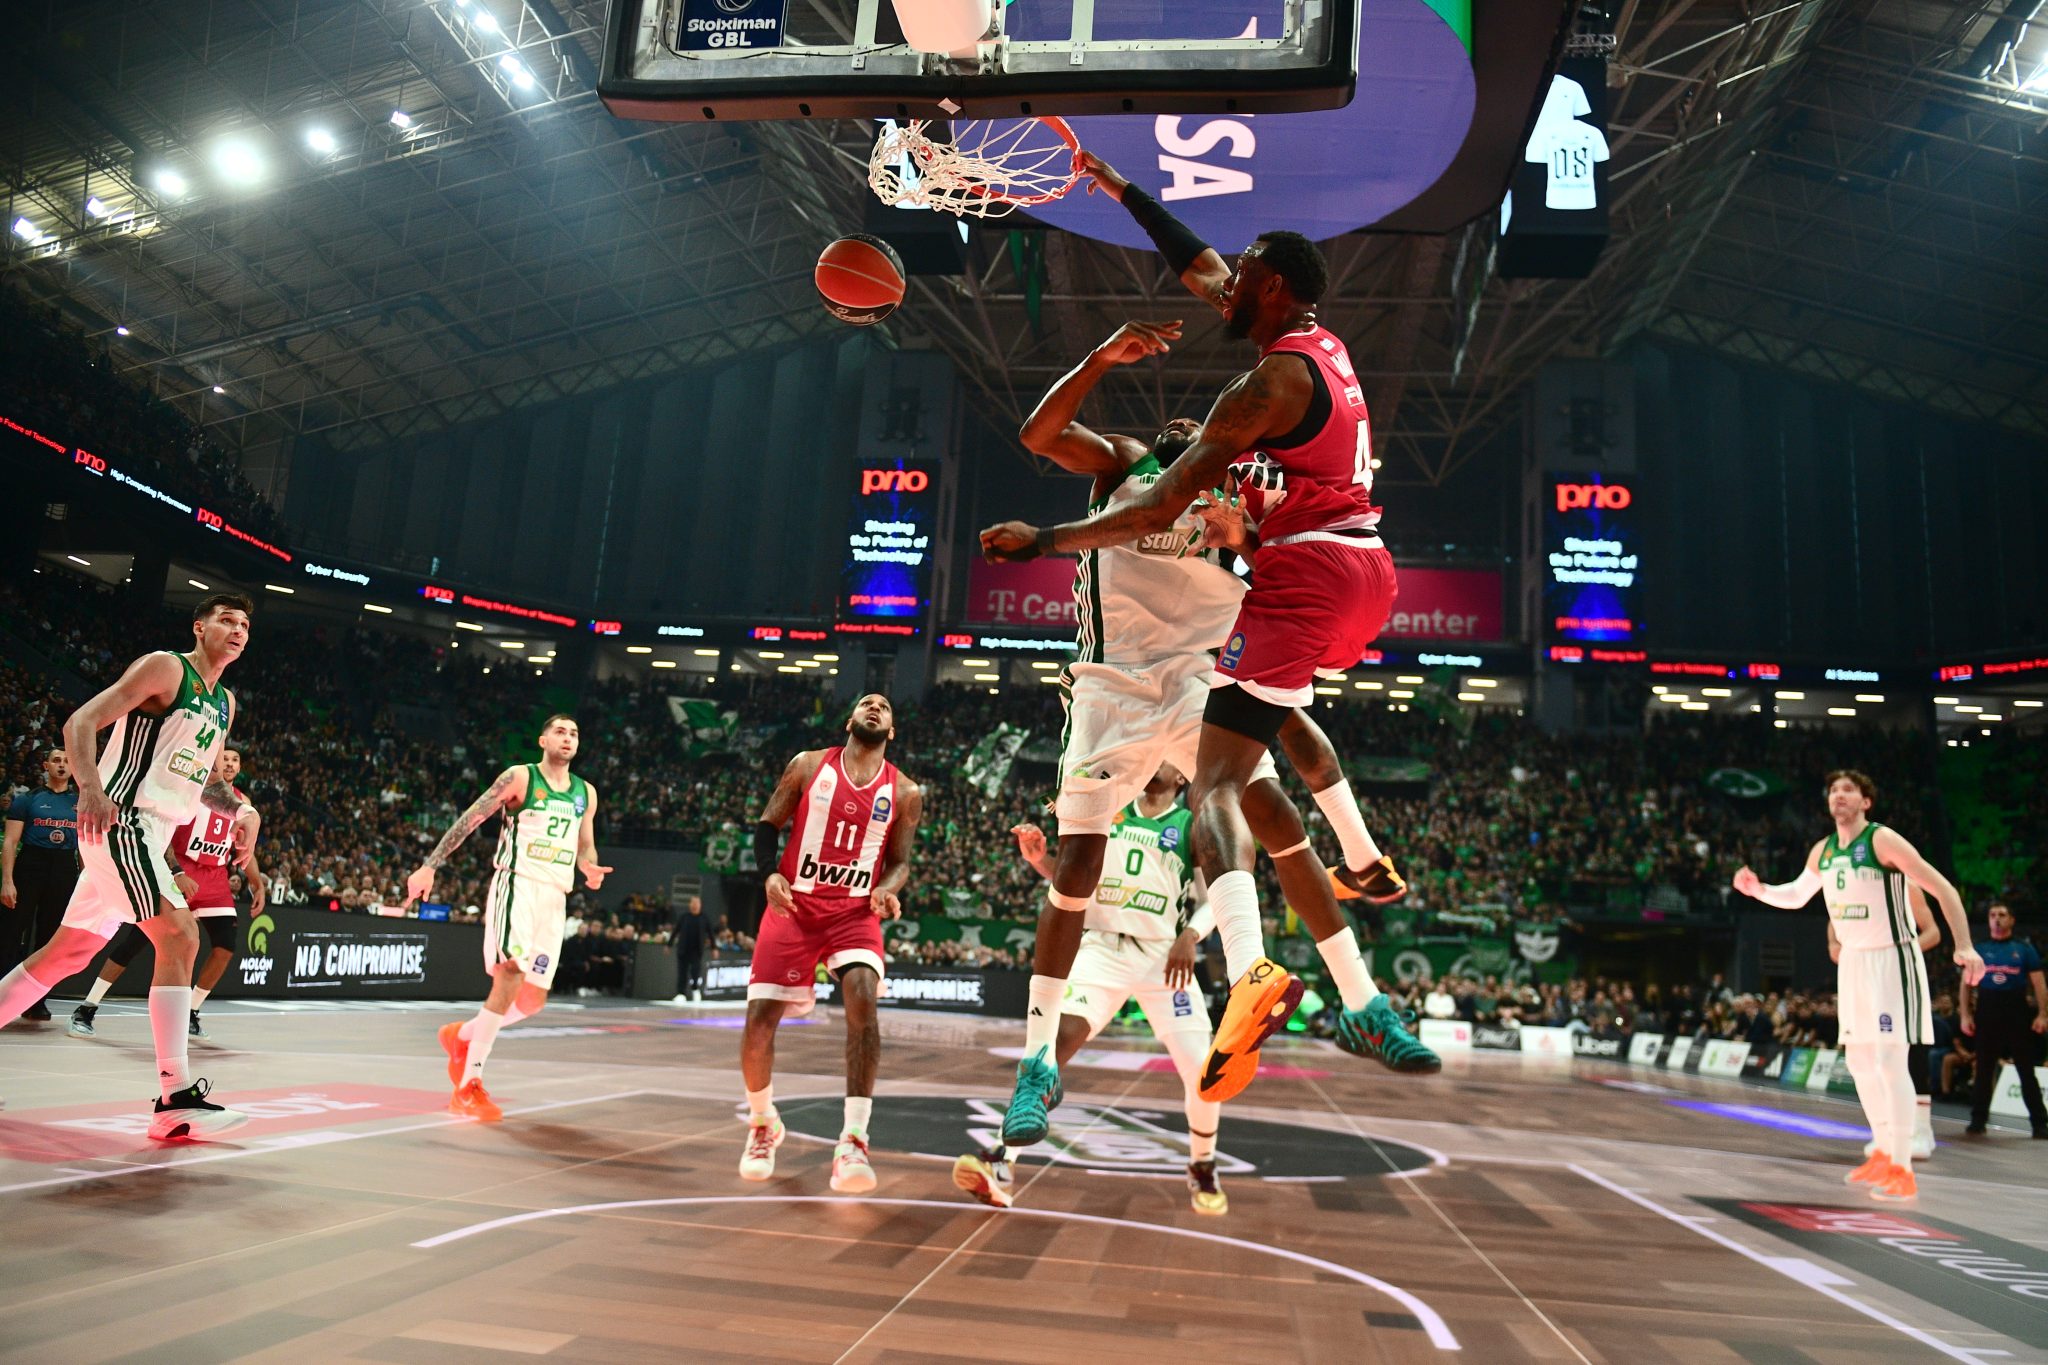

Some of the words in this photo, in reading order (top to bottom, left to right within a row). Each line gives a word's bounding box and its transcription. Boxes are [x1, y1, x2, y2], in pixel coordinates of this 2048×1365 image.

[687, 18, 776, 32] Stoiximan
[707, 31, 752, 48] GBL
[75, 448, 106, 472] pno
[110, 468, 125, 481] High
[125, 476, 157, 499] Computing
[862, 469, 929, 496] pno
[1556, 483, 1631, 512] pno
[197, 507, 223, 529] pno
[864, 519, 916, 536] Shaping
[850, 534, 871, 547] the
[871, 534, 912, 548] Future
[913, 535, 928, 548] of
[852, 548, 923, 565] Technology
[305, 562, 333, 577] Cyber
[333, 568, 370, 586] Security
[850, 594, 871, 606] pno
[1022, 594, 1079, 620] Cen
[1380, 608, 1480, 635] enter
[213, 818, 223, 835] 3
[547, 815, 571, 839] 27
[834, 820, 858, 851] 11
[799, 853, 871, 889] bwin
[1125, 848, 1144, 876] 0
[1836, 869, 1846, 890] 6
[294, 944, 321, 977] NO
[325, 941, 424, 977] COMPROMISE
[883, 977, 981, 1002] COMPROMISE
[1572, 1033, 1619, 1056] Uber
